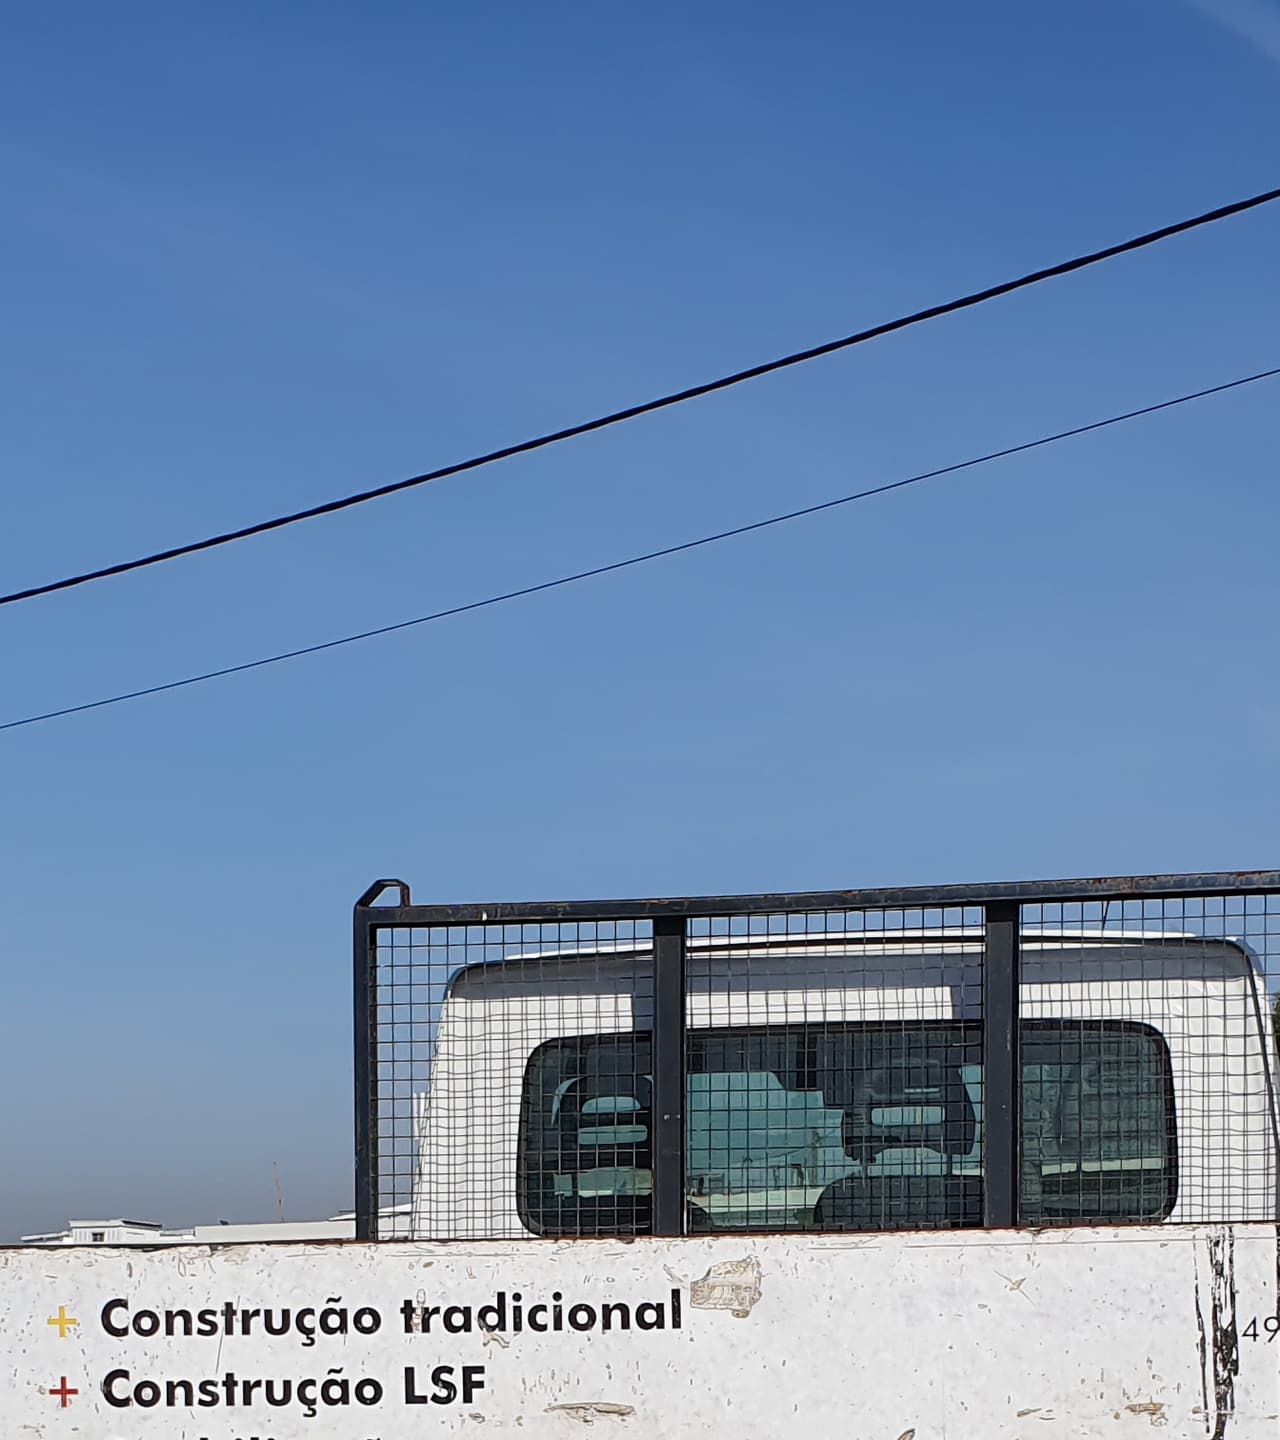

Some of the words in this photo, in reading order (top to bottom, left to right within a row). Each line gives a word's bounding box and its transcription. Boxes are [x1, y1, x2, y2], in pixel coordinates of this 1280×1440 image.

[100, 1297, 382, 1347] Construção
[400, 1288, 683, 1335] tradicional
[102, 1366, 383, 1417] Construção
[403, 1365, 487, 1405] LSF
